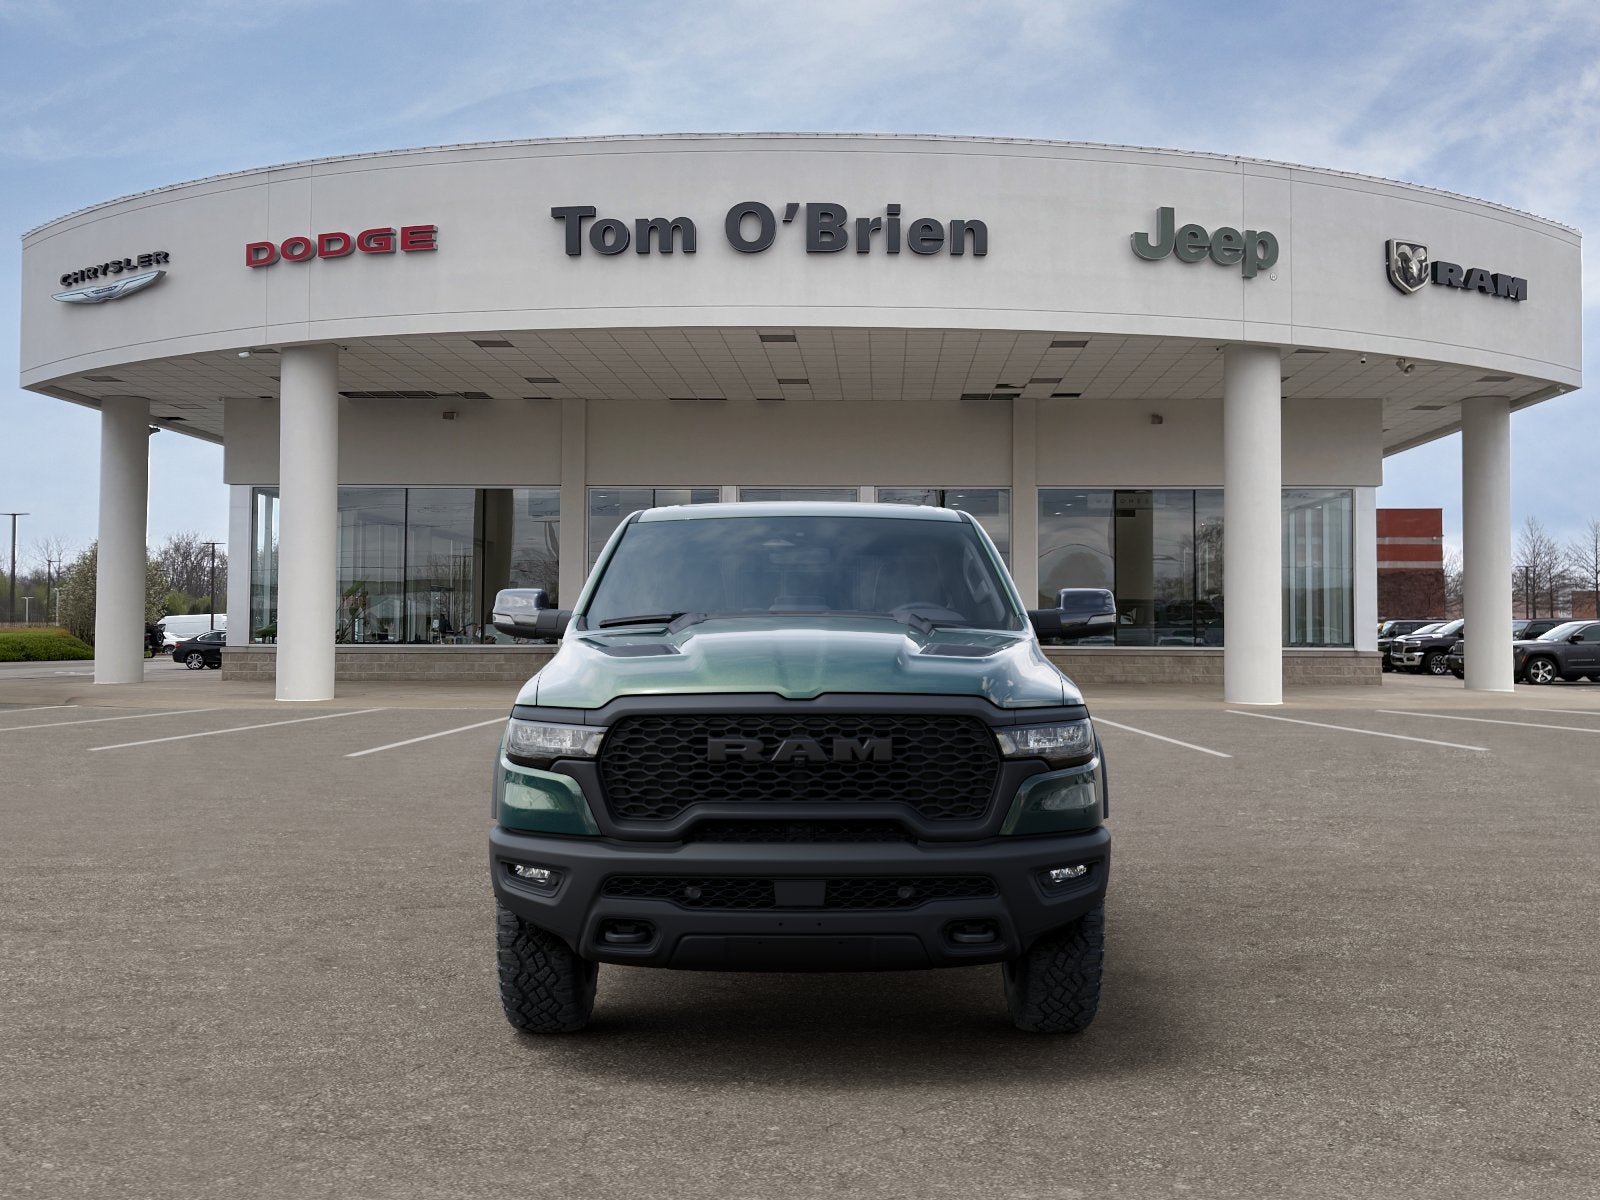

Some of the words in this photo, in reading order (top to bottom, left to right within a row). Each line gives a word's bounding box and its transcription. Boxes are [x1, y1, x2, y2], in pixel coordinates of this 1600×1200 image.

[246, 225, 437, 268] DODGE
[551, 205, 697, 256] Tom
[725, 201, 988, 256] O'Brien
[1131, 206, 1279, 278] Jeep
[60, 251, 169, 286] CHRYSLER
[1431, 260, 1527, 301] RAM
[707, 737, 893, 761] RAM
